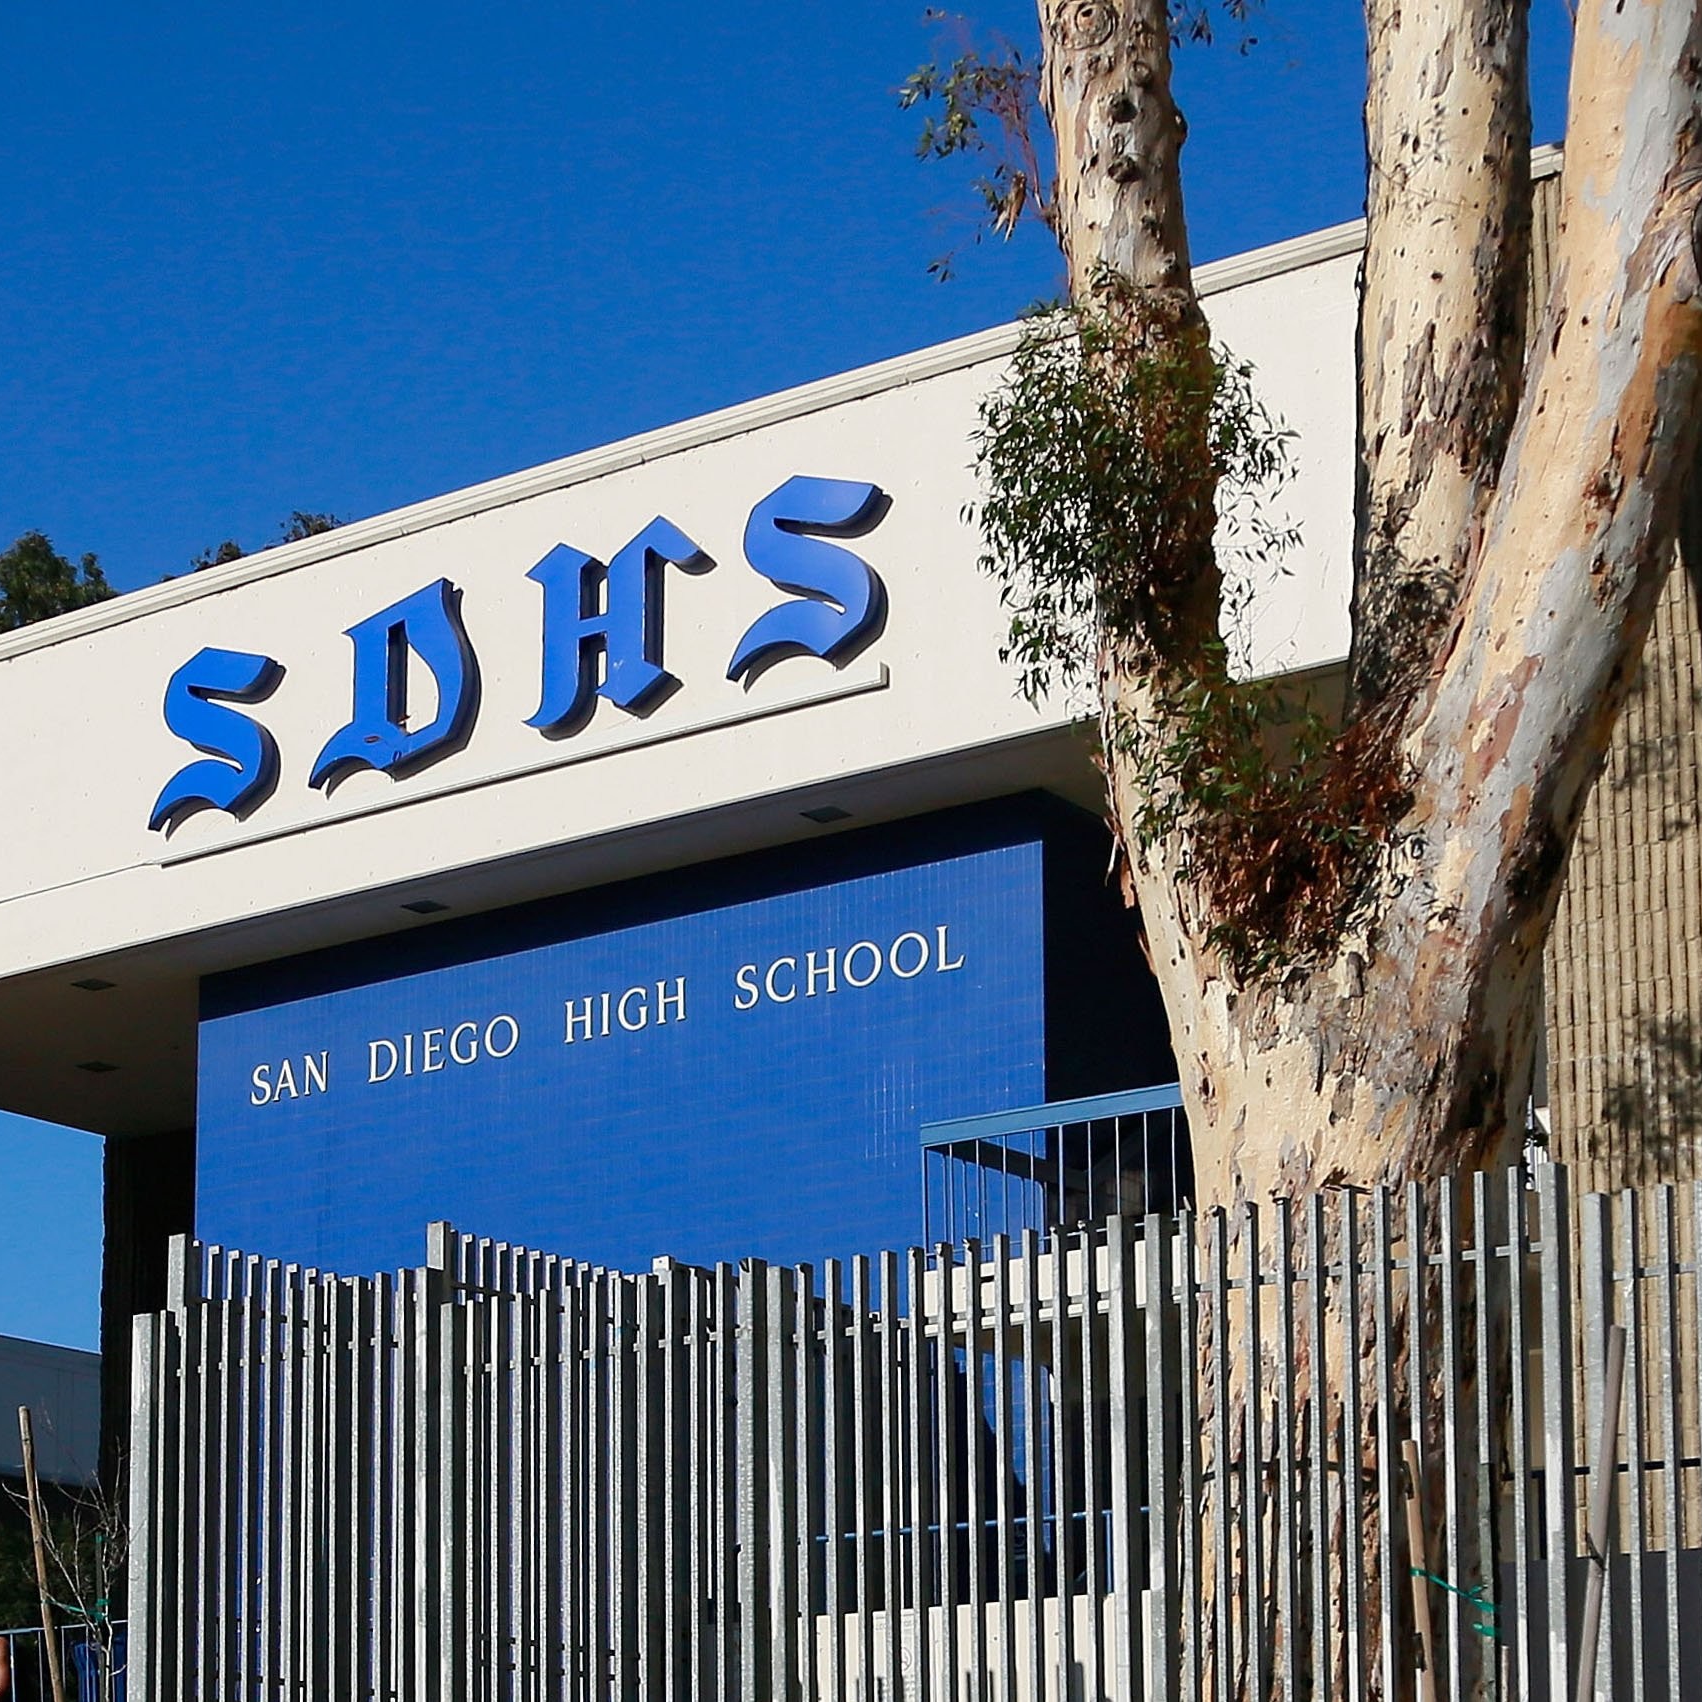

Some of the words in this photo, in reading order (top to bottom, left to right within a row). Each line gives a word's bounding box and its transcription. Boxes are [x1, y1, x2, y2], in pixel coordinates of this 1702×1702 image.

[148, 475, 892, 836] SDHS
[250, 1050, 329, 1106] SAN
[368, 1015, 520, 1084] DIEGO
[564, 976, 687, 1044] HIGH
[733, 925, 965, 1009] SCHOOL
